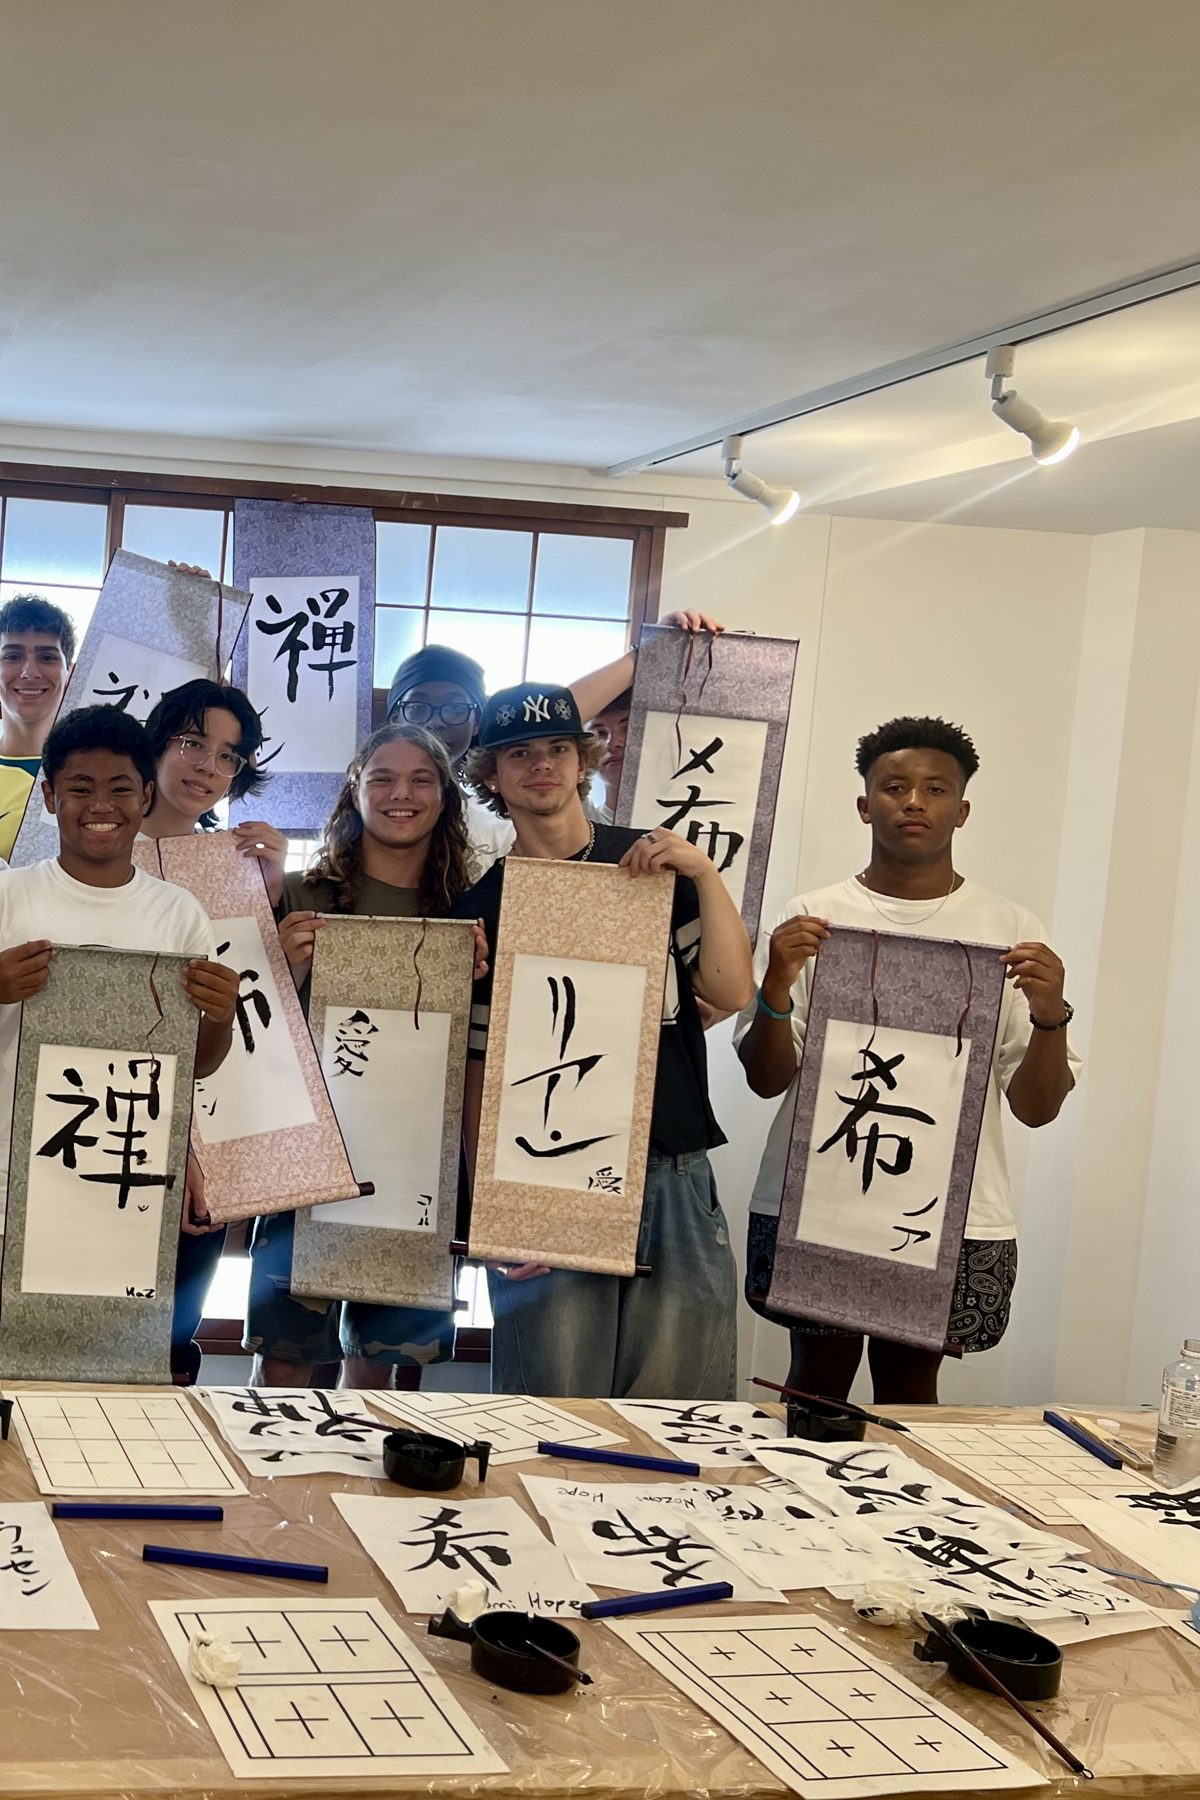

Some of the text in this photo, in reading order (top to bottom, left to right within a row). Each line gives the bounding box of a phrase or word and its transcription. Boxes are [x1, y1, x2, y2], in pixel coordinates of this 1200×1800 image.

[327, 1009, 380, 1078] 愛
[816, 1047, 937, 1196] 希
[527, 1591, 582, 1614] Hope
